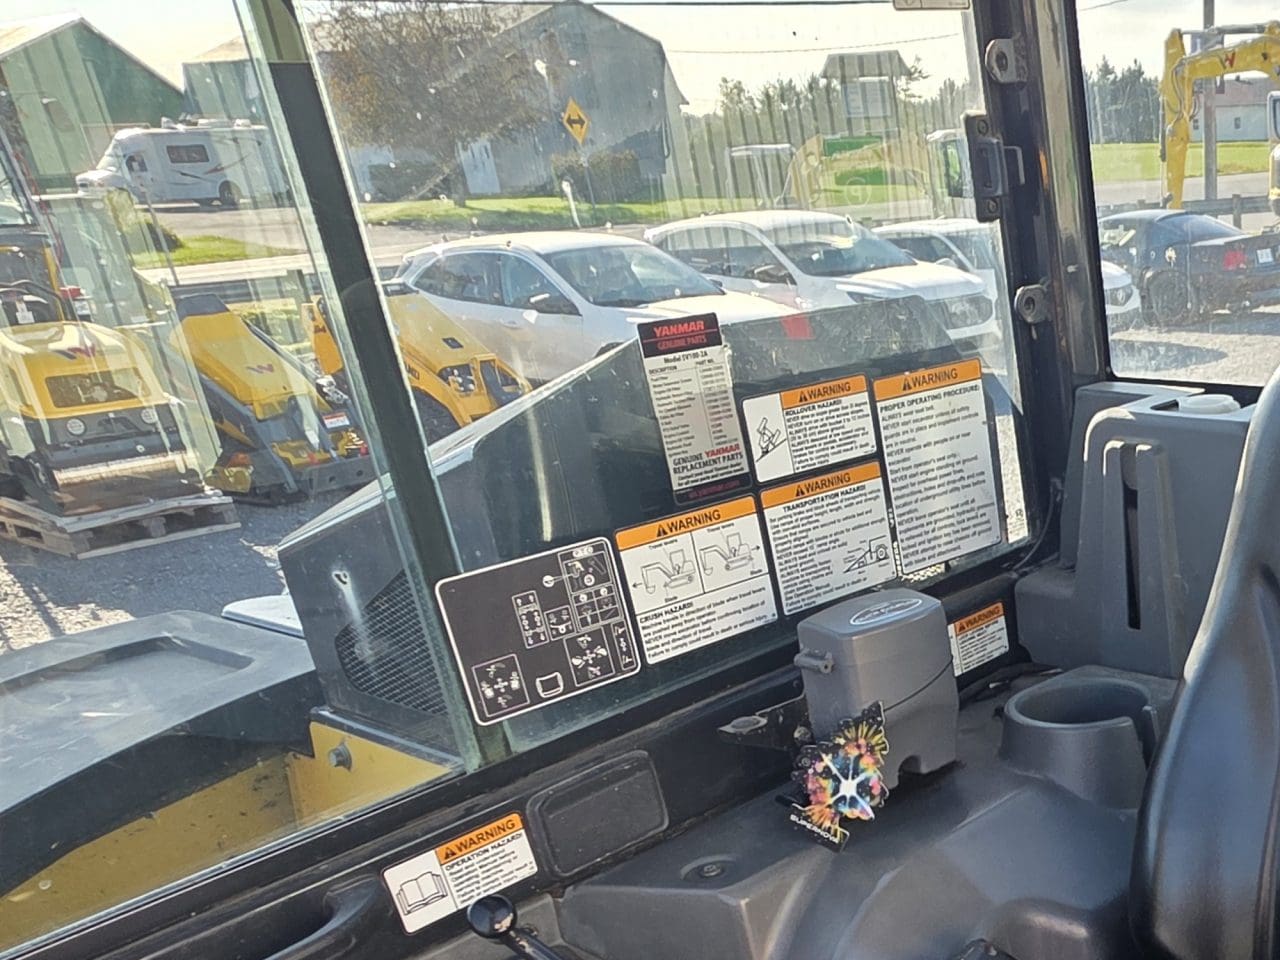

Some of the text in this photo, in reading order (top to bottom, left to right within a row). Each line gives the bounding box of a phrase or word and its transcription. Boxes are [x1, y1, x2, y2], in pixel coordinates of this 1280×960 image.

[654, 320, 703, 337] YANMAR
[686, 333, 706, 344] PARTS
[663, 354, 680, 363] Model
[912, 368, 957, 387] WARNING
[808, 382, 850, 399] WARNING
[785, 405, 814, 416] ROLLOVER
[880, 401, 904, 412] PROPER
[907, 393, 941, 406] OPERATING
[672, 444, 739, 465] GENUINE YANMAR
[673, 451, 742, 474] REPLACEMENT PARTS
[805, 473, 850, 493] WARNING
[784, 492, 838, 511] TRANSPORTATION
[667, 510, 720, 532] WARNING
[639, 611, 663, 623] CRUSH
[455, 819, 514, 851] WARNING
[445, 848, 488, 870] OPERATION
